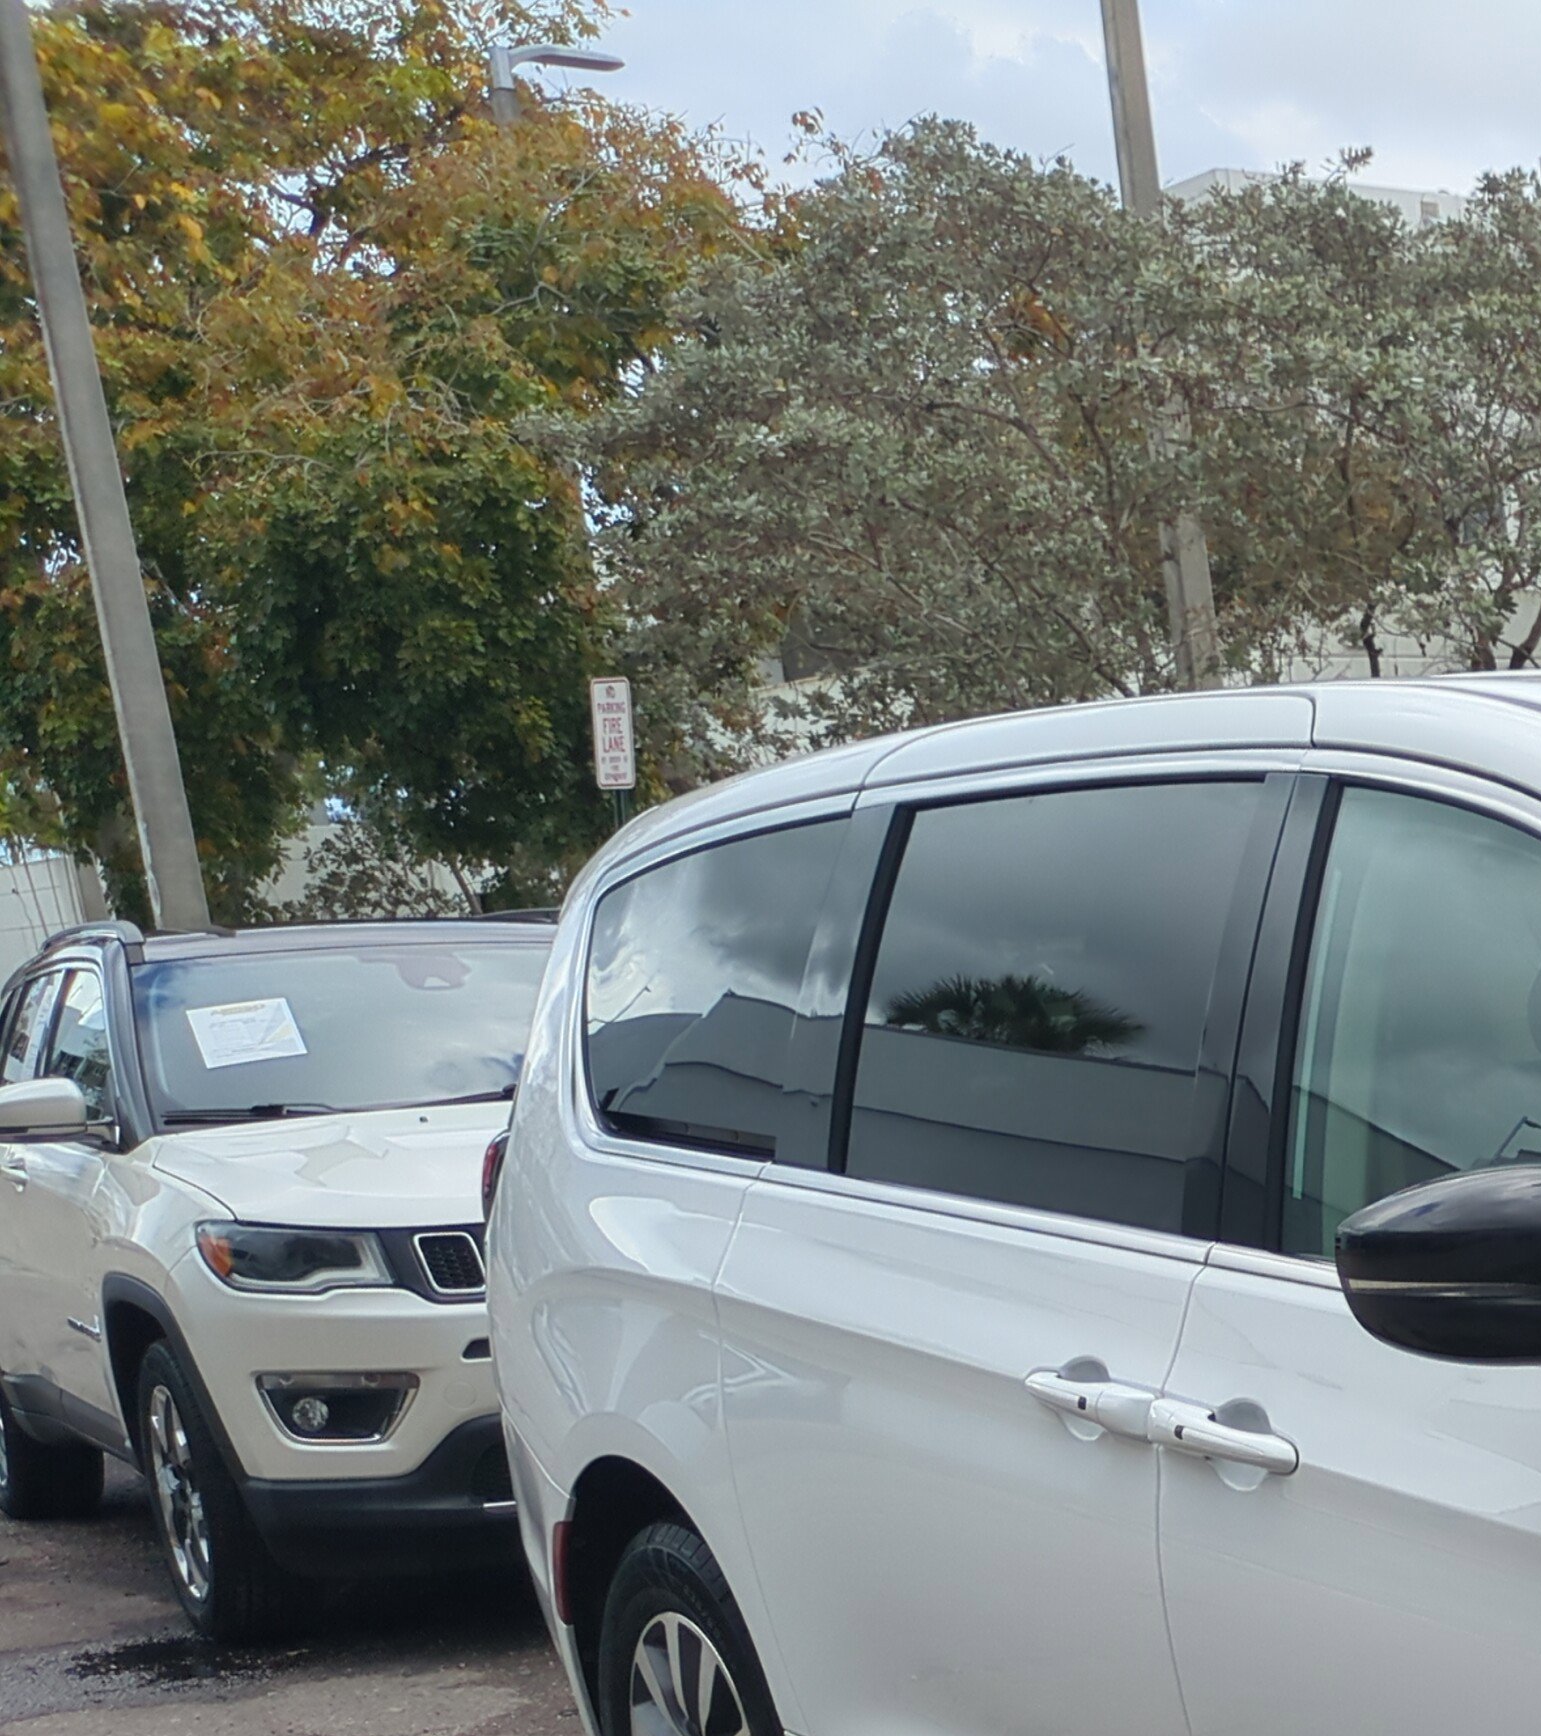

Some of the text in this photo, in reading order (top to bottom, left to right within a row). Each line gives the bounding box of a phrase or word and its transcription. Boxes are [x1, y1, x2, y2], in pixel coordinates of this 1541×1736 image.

[597, 702, 626, 714] PARKING
[602, 717, 623, 734] FIRE
[602, 735, 626, 753] LANE
